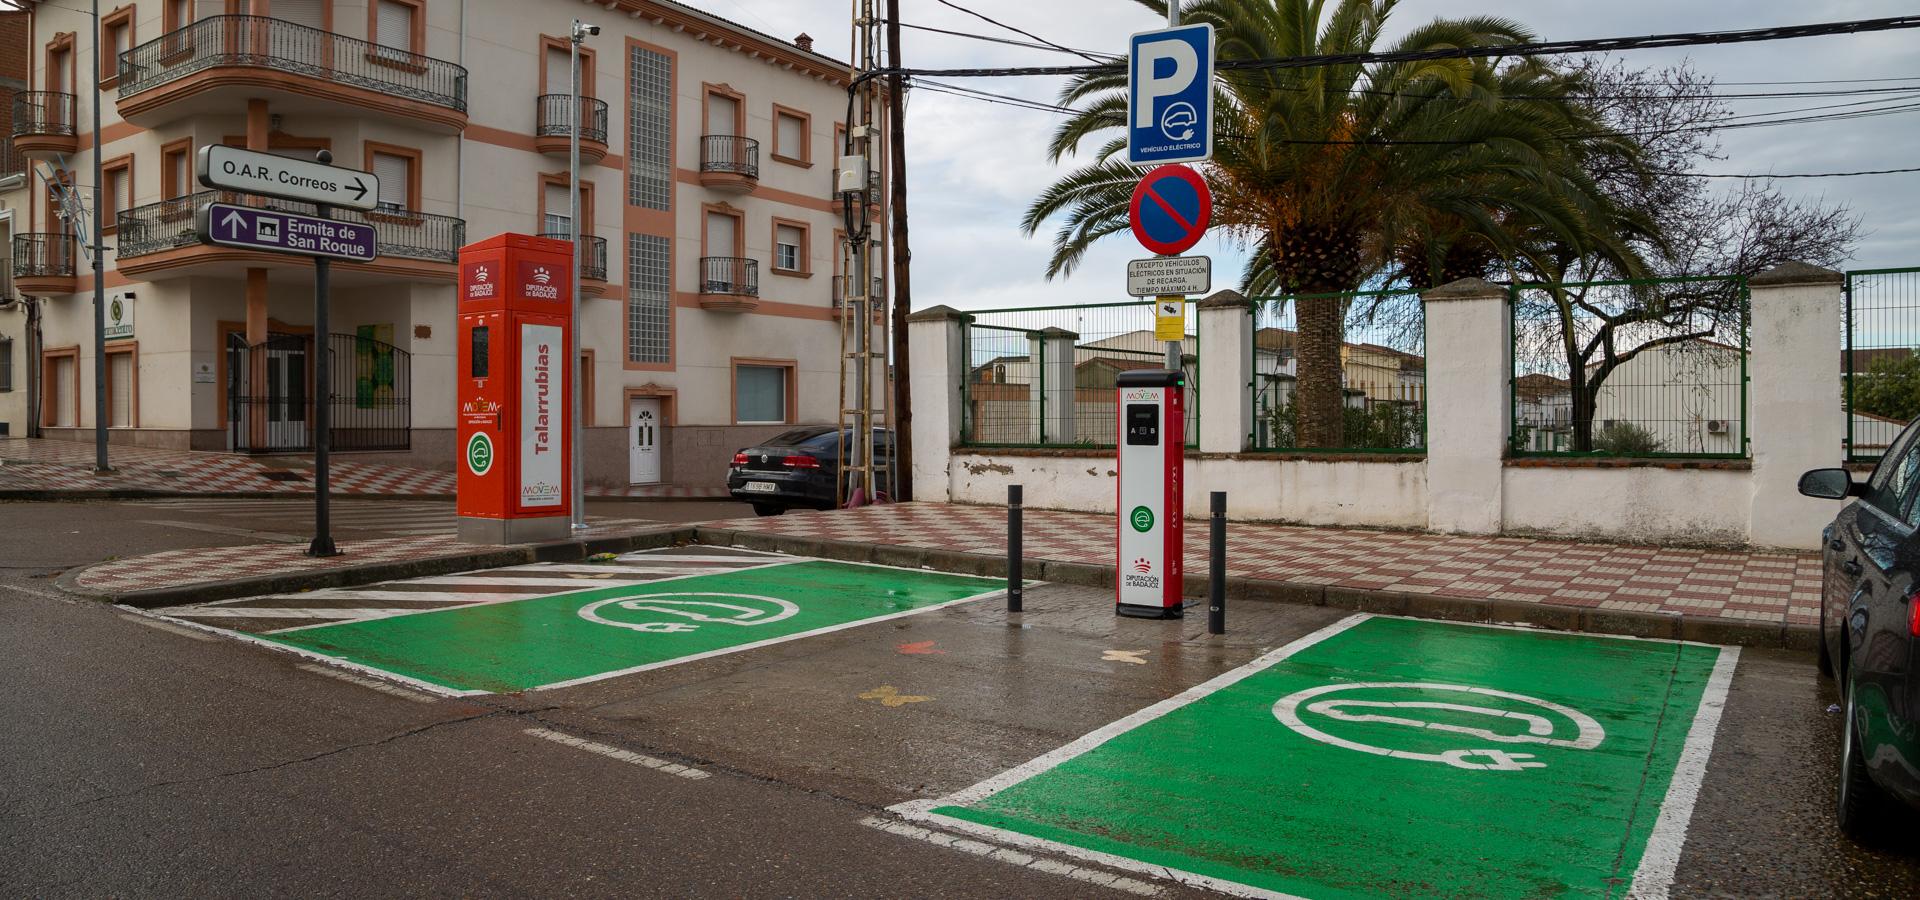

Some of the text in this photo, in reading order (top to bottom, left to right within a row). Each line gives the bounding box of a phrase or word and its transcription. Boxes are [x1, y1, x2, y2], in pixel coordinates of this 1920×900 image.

[1136, 39, 1198, 128] P
[1140, 142, 1200, 153] VEHÍCULO ELÉCTRICO
[223, 160, 337, 192] O.A.R. Correos
[287, 219, 356, 240] Ermita de
[287, 233, 365, 256] San Roque
[1136, 261, 1163, 269] EXCEPTO
[1130, 269, 1165, 278] ELÉCTRICOS
[1175, 266, 1206, 274] SITUACIÓN
[526, 284, 557, 293] DIPUTACIÓN
[532, 291, 557, 299] BADAJOZ
[535, 344, 548, 455] Talarrubias
[523, 485, 559, 494] MOVEM
[1126, 574, 1159, 582] DIPUTACIÓN
